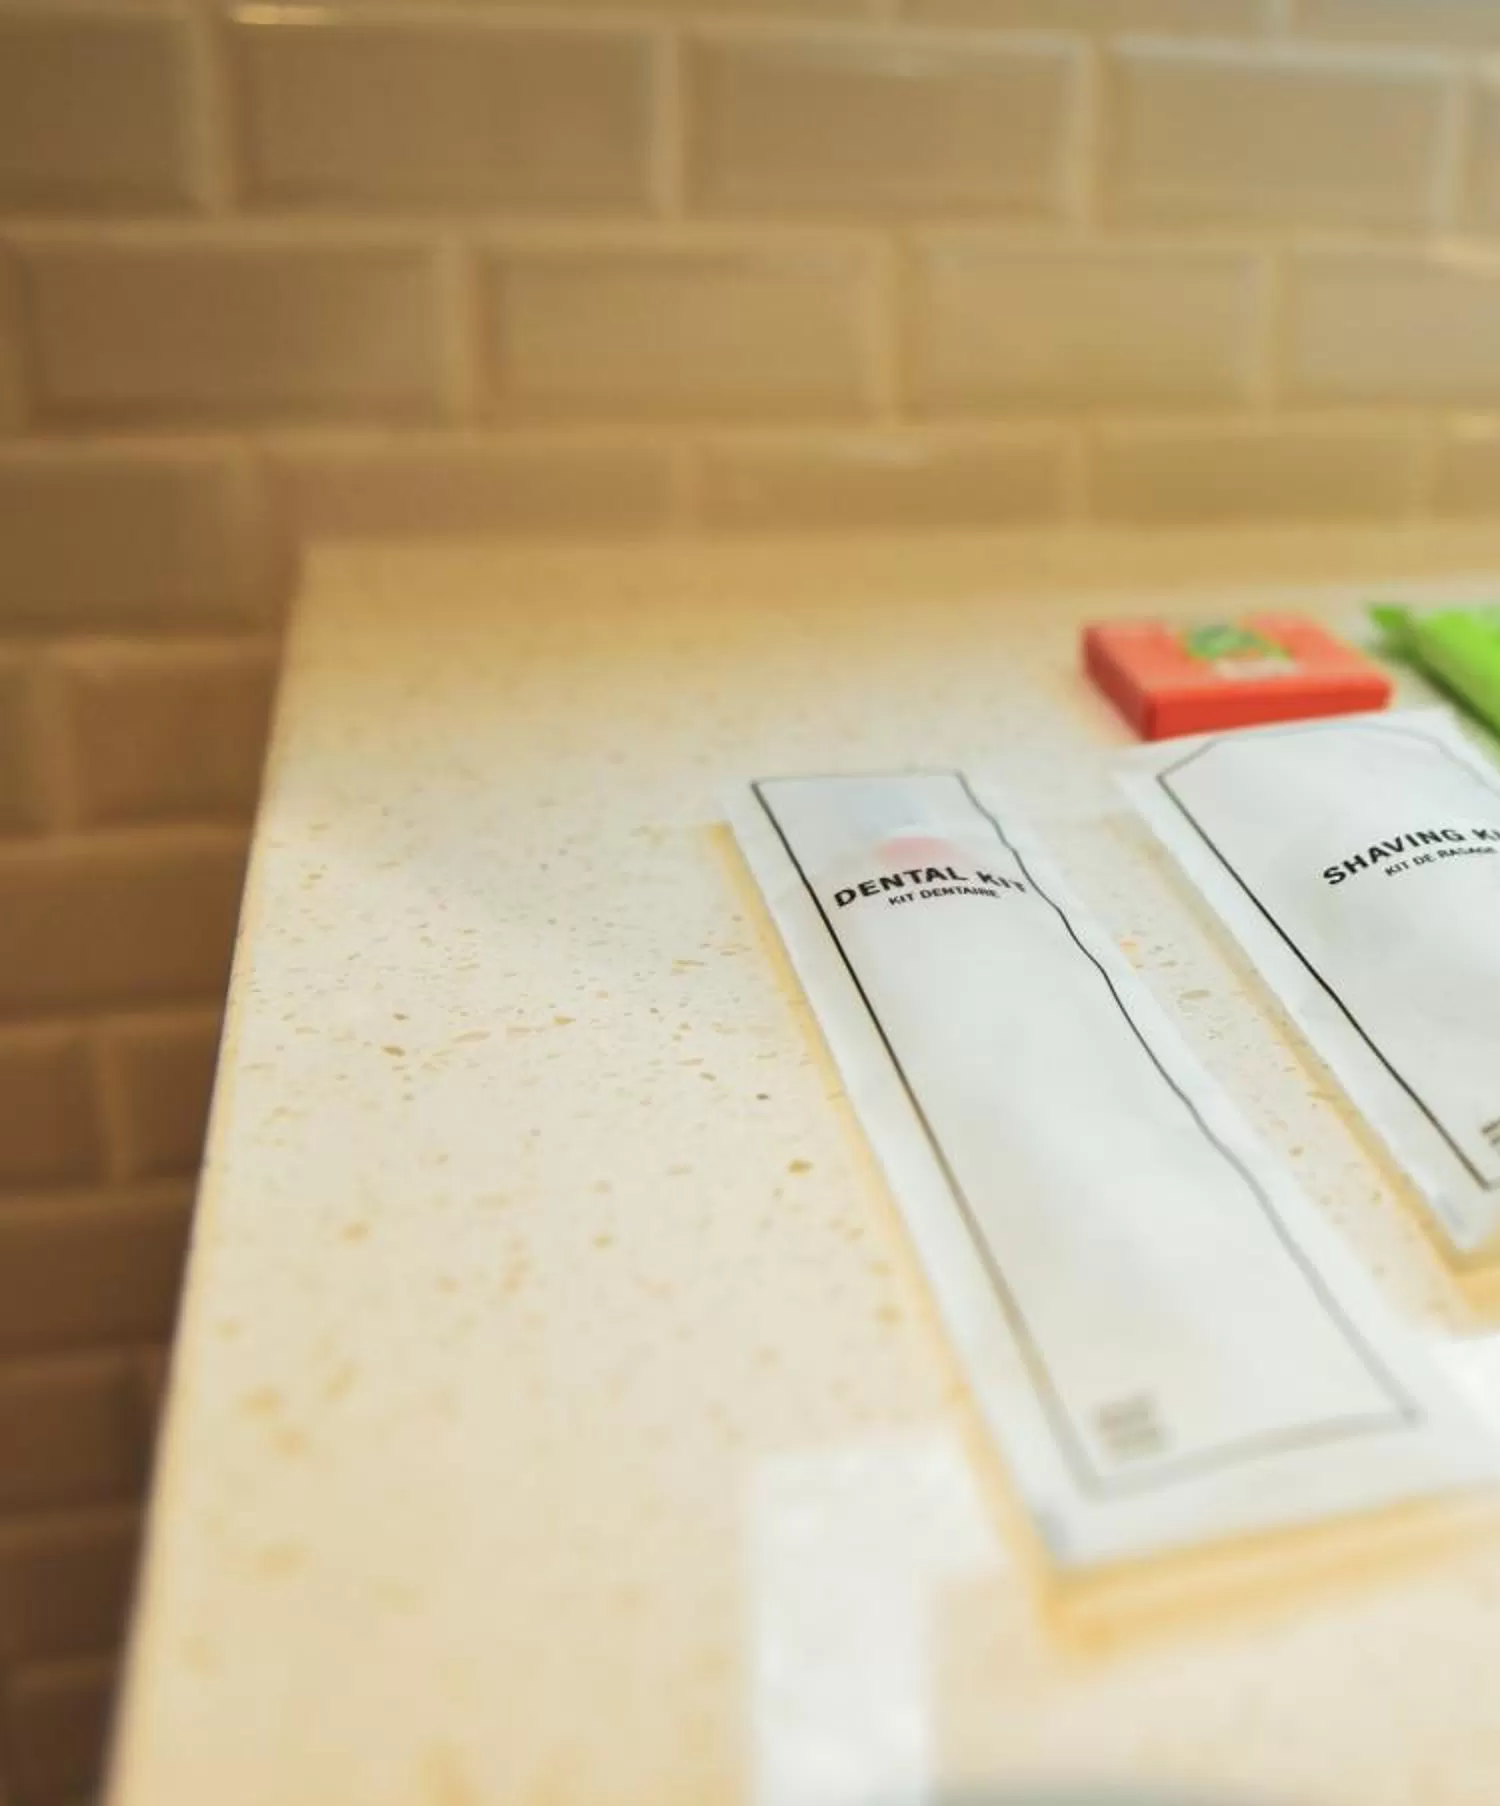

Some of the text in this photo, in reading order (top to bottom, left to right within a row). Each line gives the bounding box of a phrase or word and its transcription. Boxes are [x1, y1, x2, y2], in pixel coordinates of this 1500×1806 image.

[1323, 828, 1466, 885] SHAVING
[1384, 860, 1411, 877] KIT
[1412, 852, 1436, 867] DE
[833, 866, 1027, 907] DENTAL KIT
[888, 884, 1000, 906] KIT DENTAIRE
